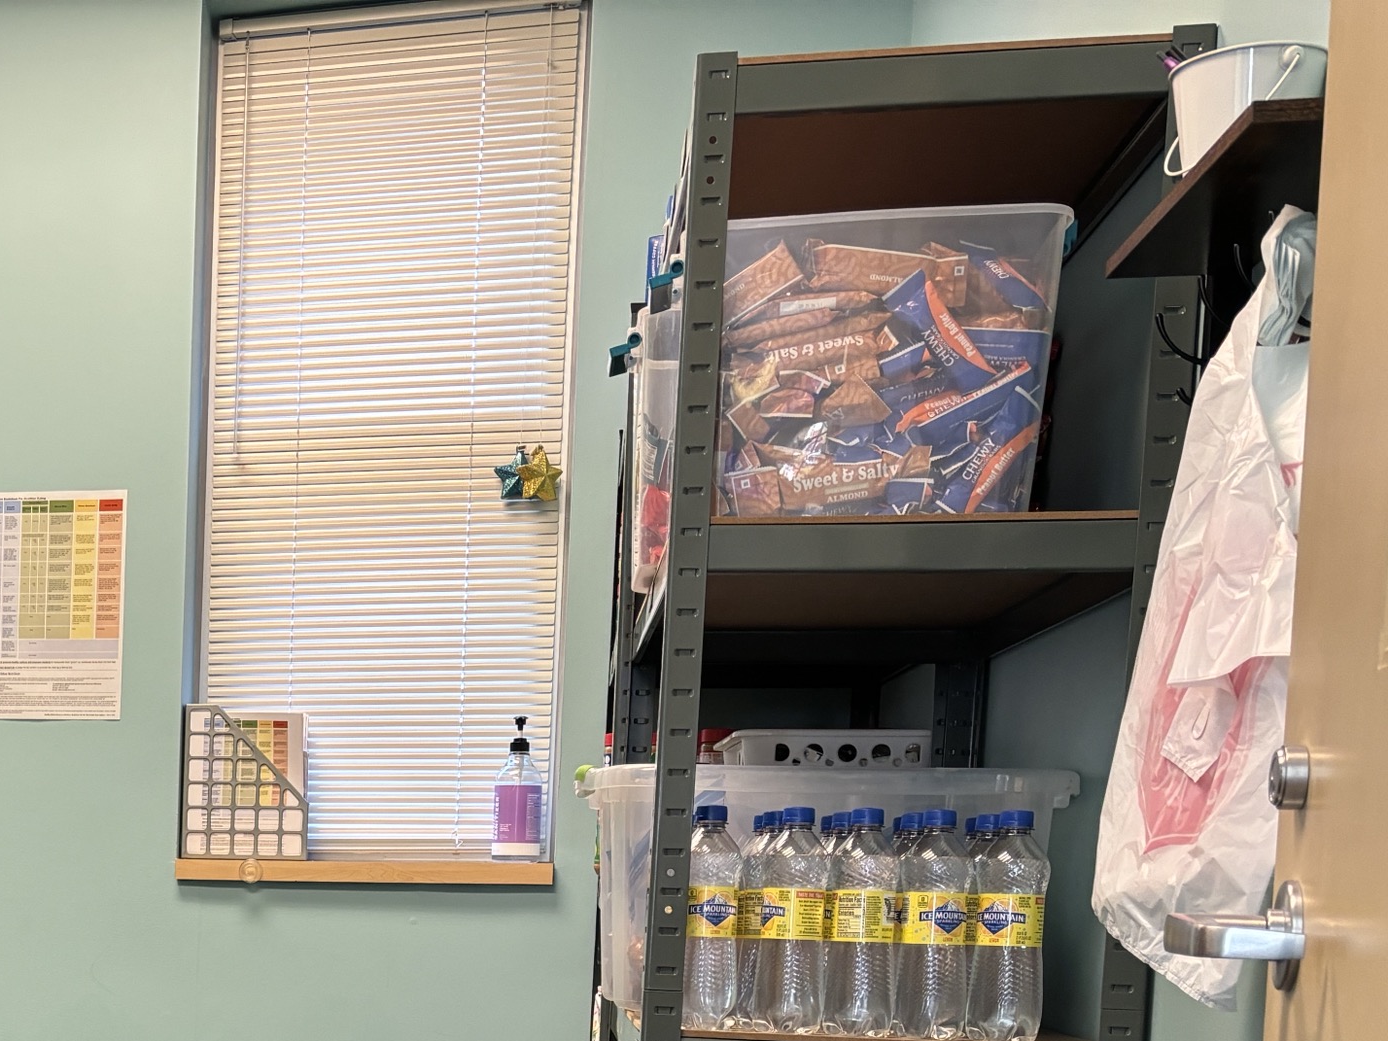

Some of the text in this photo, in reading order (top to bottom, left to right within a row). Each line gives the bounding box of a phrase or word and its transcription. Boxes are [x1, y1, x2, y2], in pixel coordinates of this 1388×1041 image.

[983, 259, 1010, 279] CHEWY
[818, 335, 865, 353] Sweet
[939, 313, 976, 358] Peanut Butter
[921, 330, 954, 367] CHEWY
[962, 437, 996, 481] CHEWY
[793, 463, 900, 493] Sweet & Salty
[976, 447, 1016, 495] Peanut Butter
[827, 491, 869, 503] ALMOND
[690, 905, 701, 913] ICE
[921, 912, 932, 920] ICE
[983, 912, 1025, 923] MOUNTAIN
